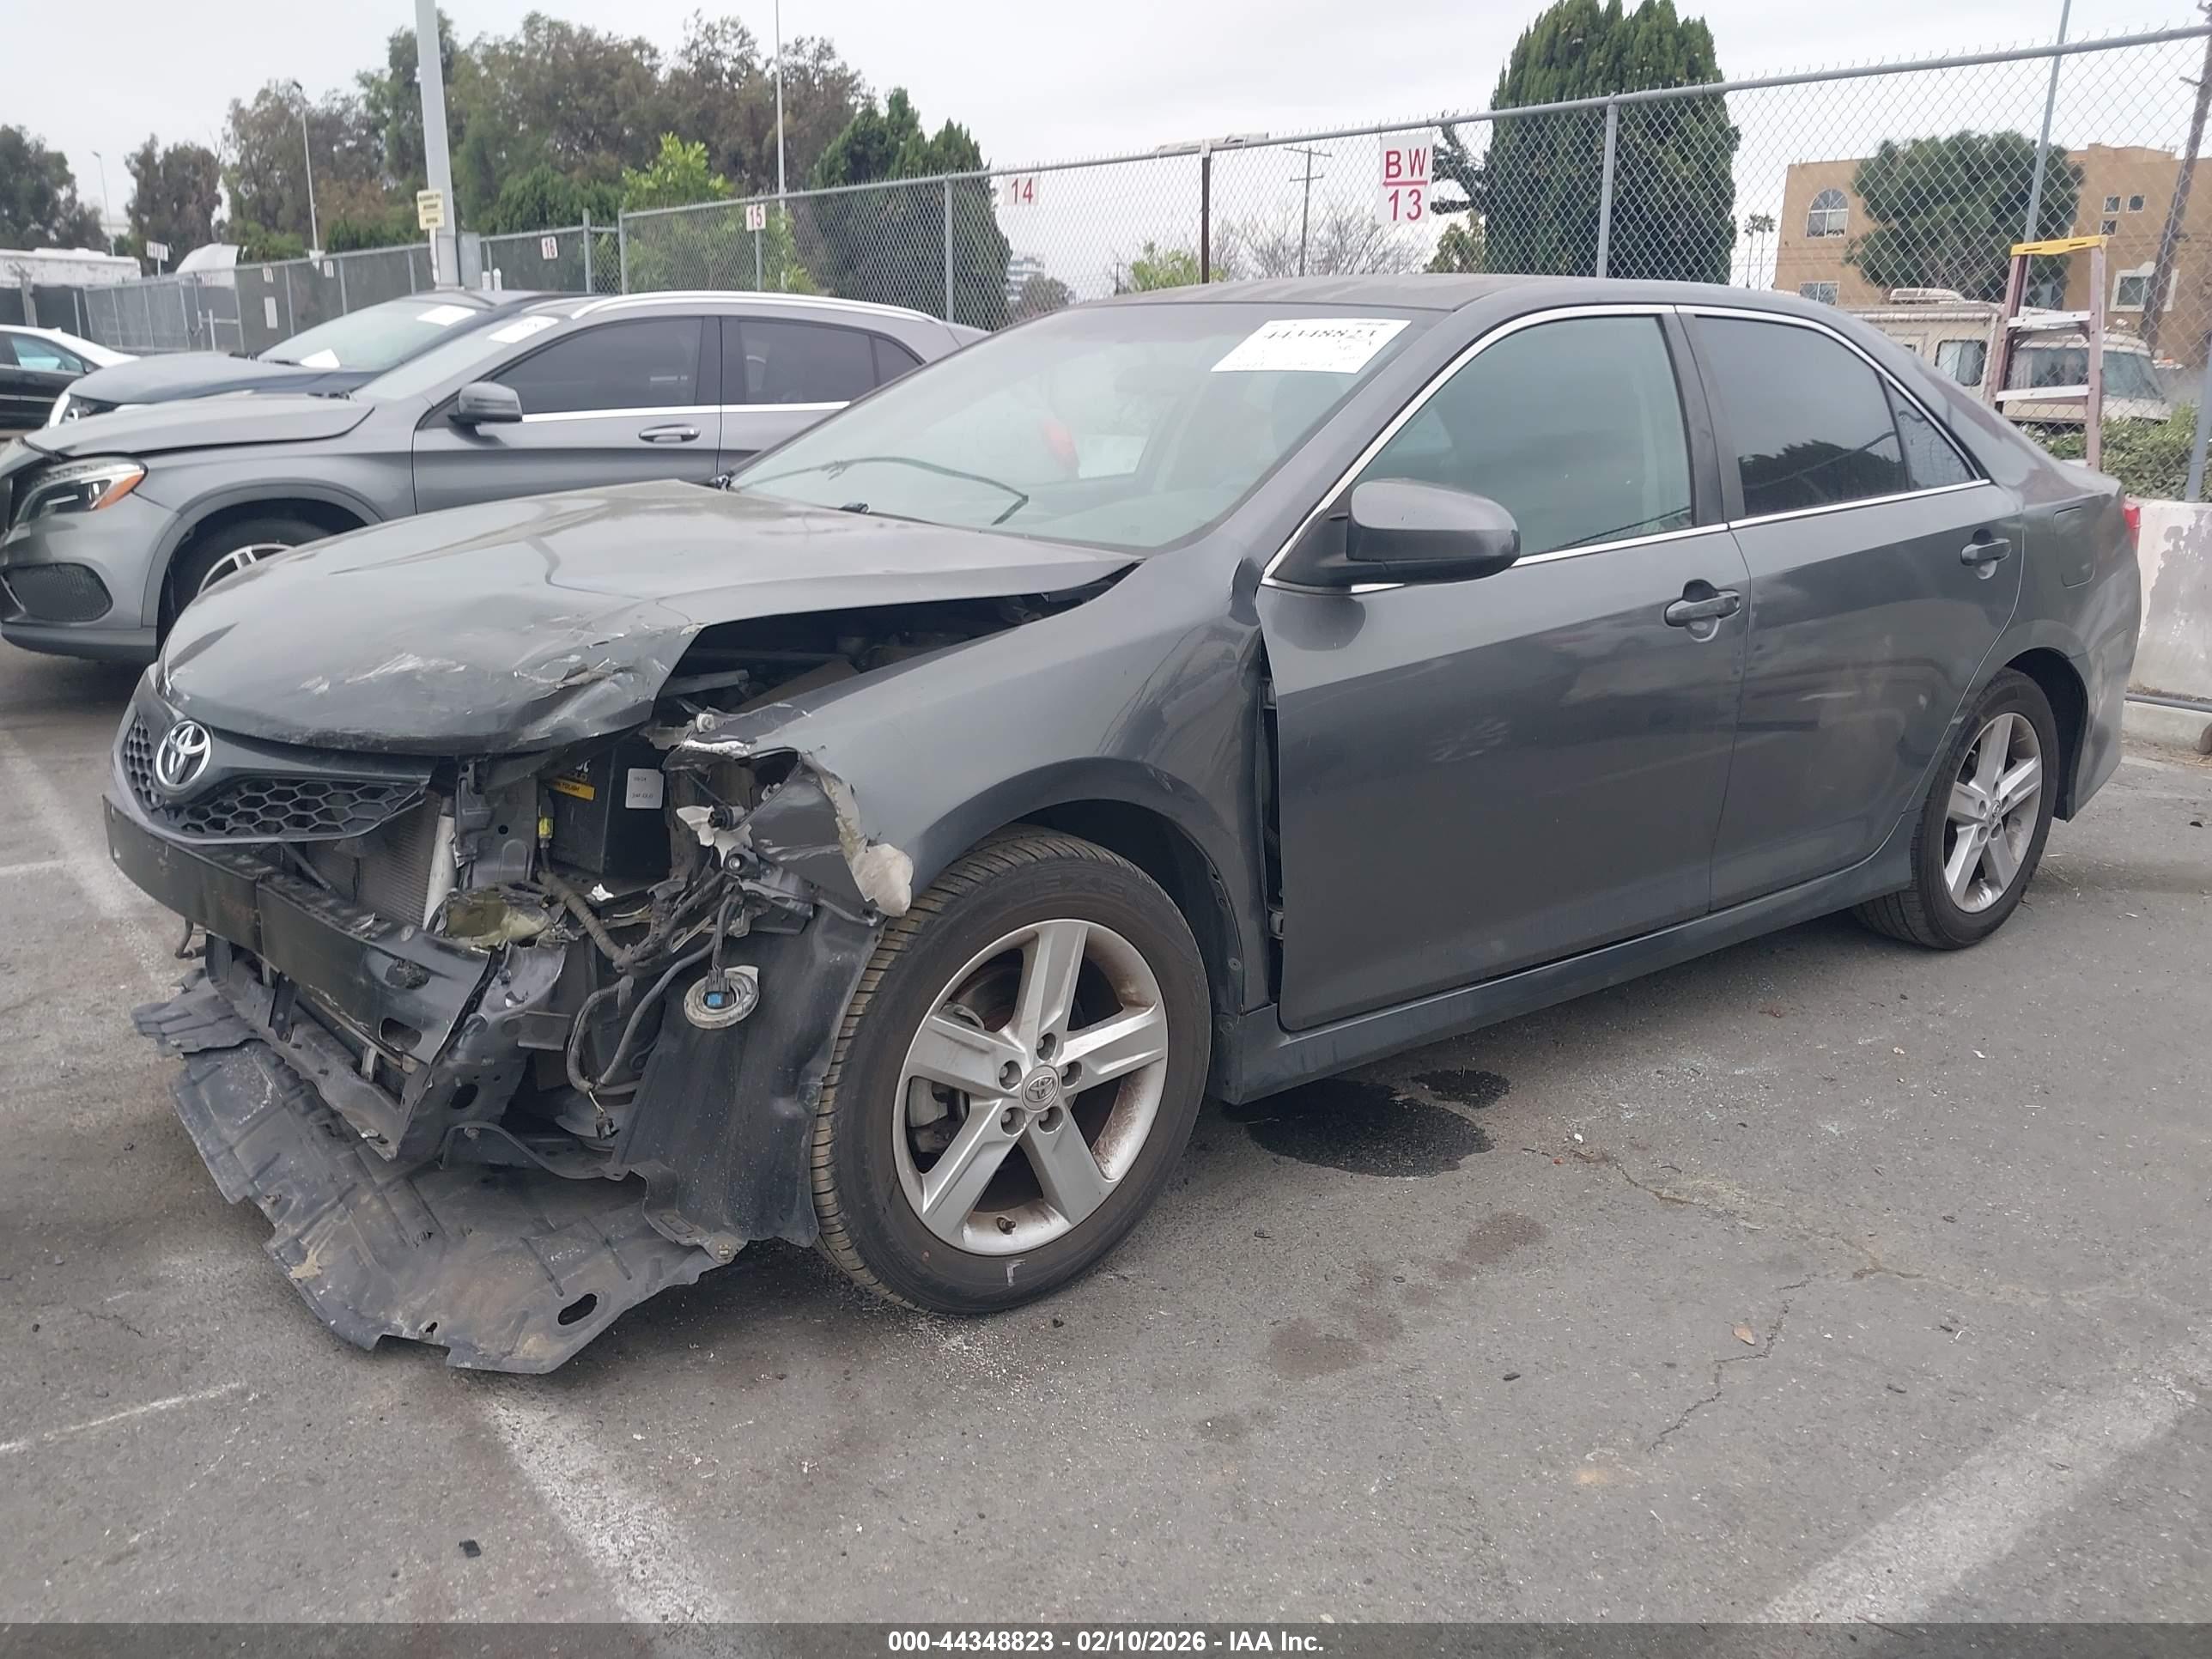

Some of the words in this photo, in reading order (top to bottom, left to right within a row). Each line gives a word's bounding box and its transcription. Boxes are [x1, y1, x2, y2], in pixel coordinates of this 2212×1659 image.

[1385, 148, 1426, 179] BW
[1012, 177, 1034, 205] 14
[750, 205, 763, 228] 15
[1388, 189, 1422, 222] 13
[544, 238, 556, 257] 16
